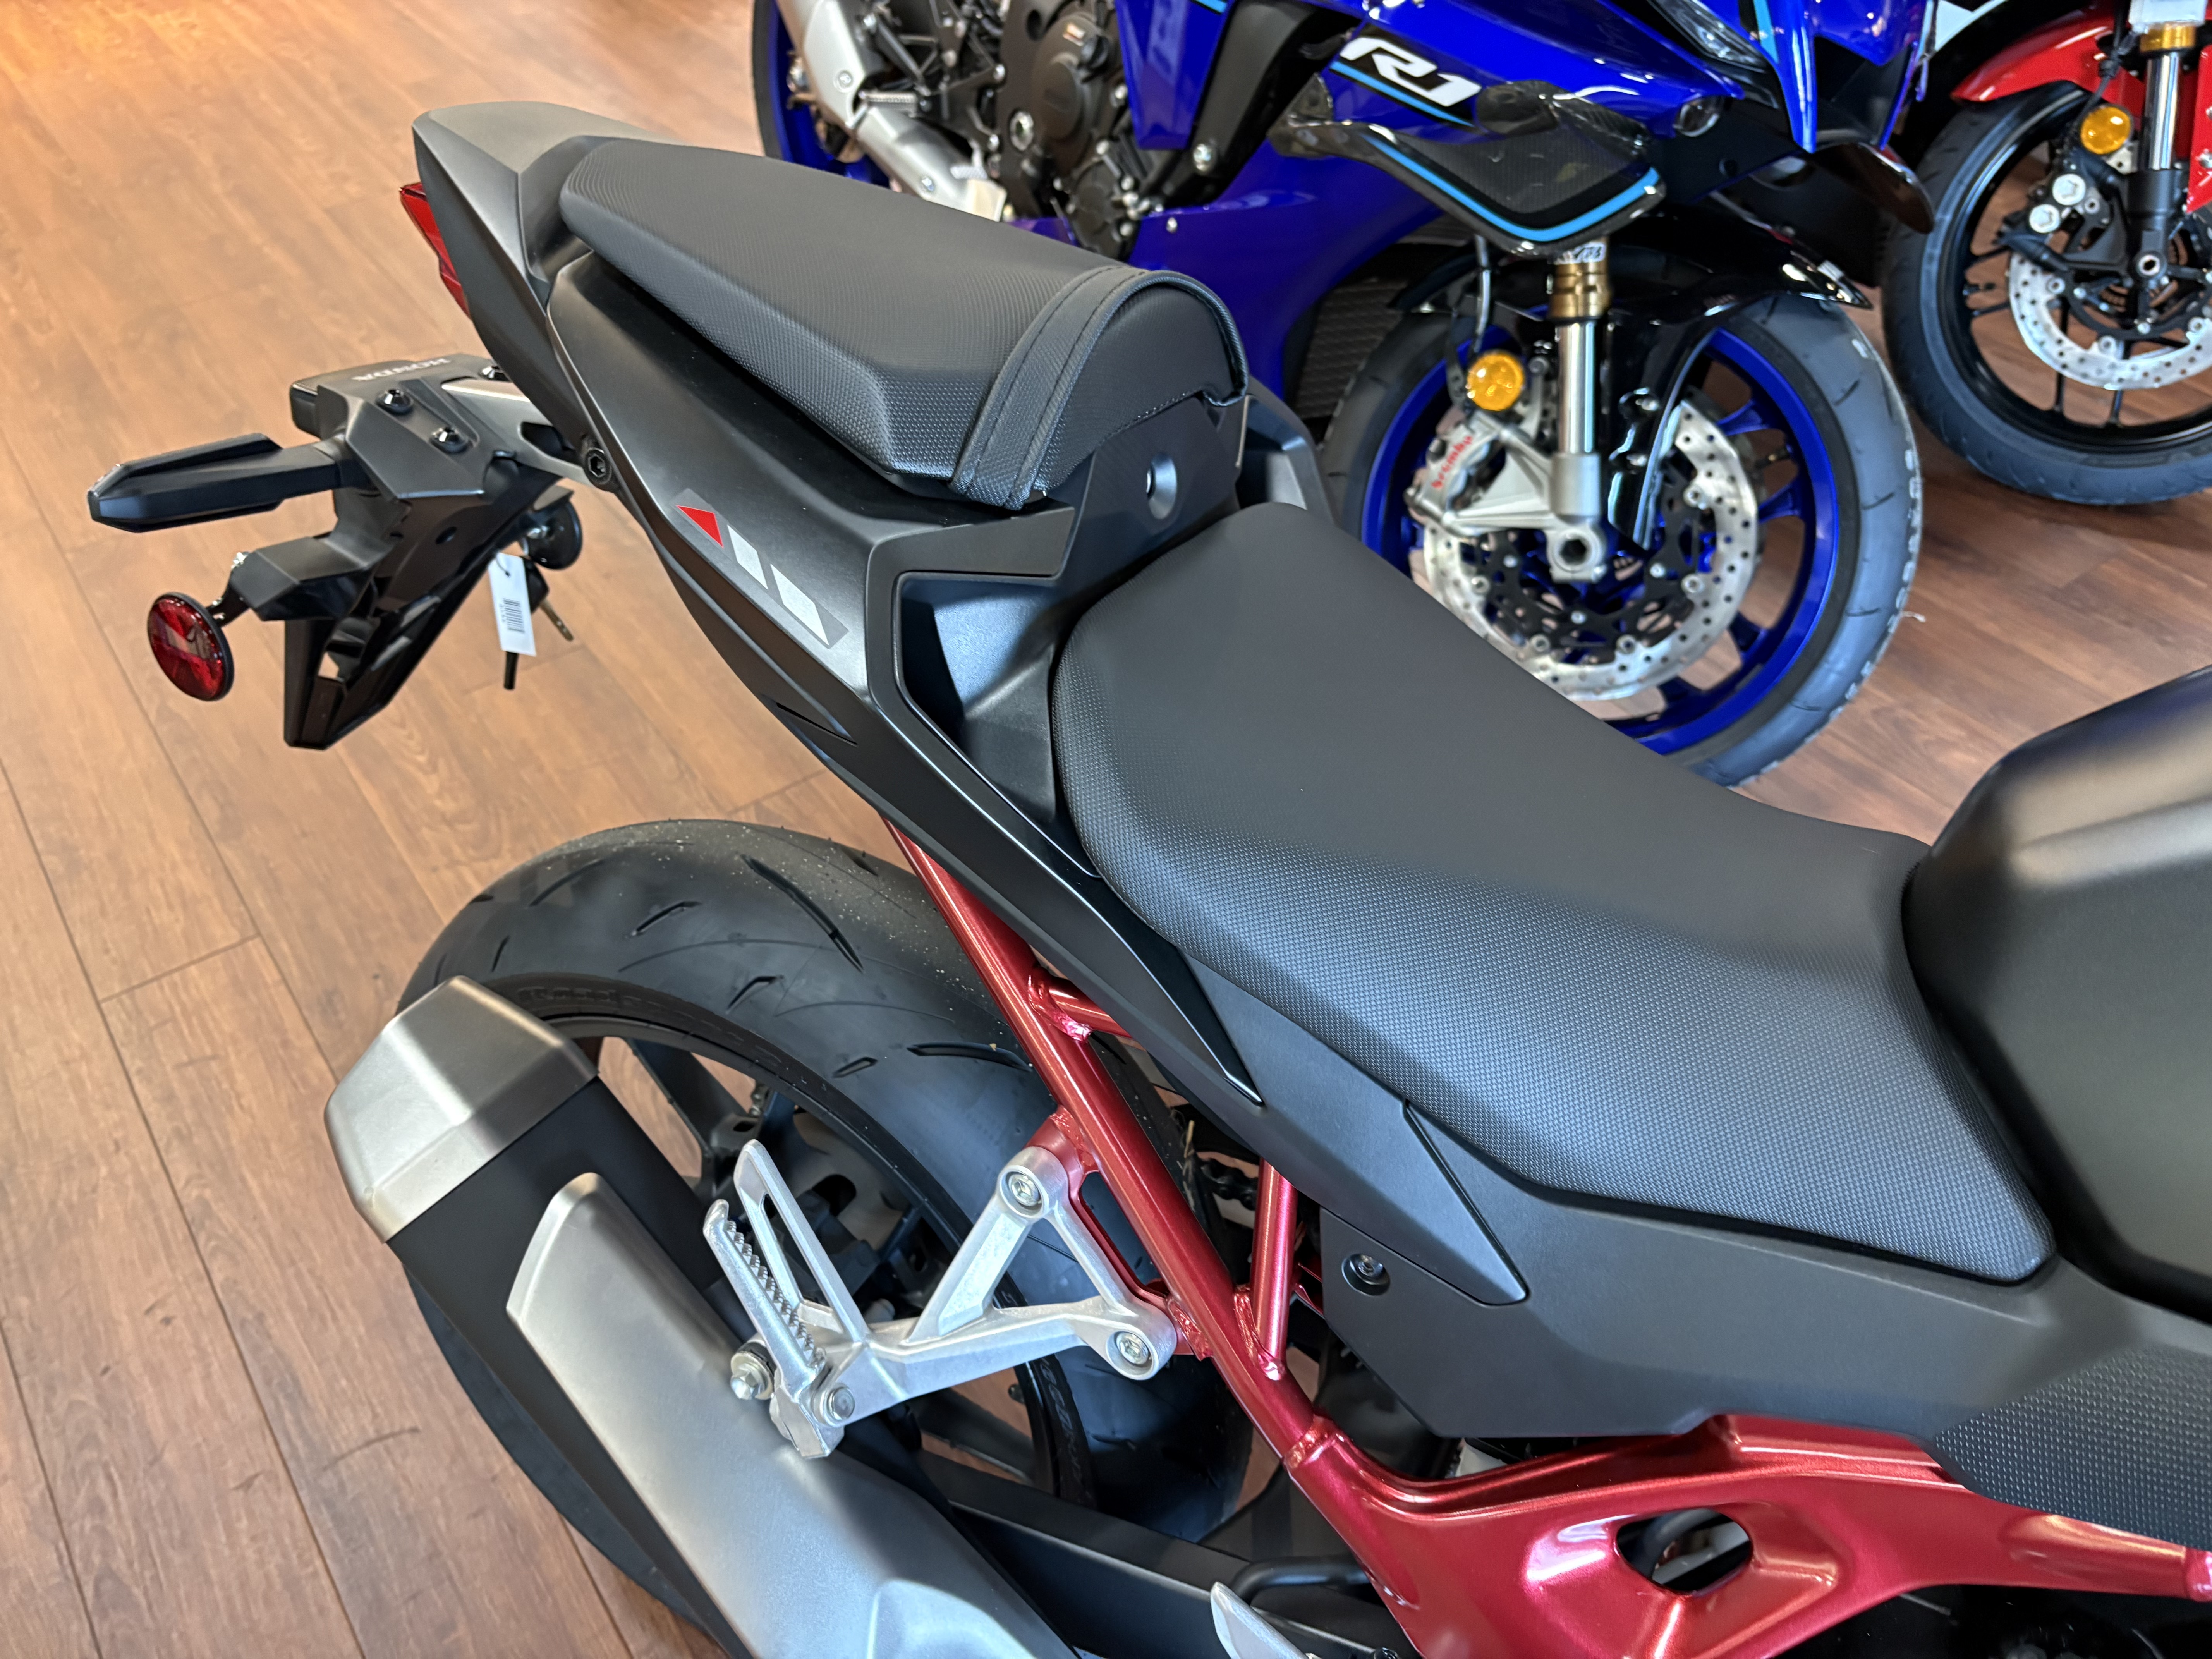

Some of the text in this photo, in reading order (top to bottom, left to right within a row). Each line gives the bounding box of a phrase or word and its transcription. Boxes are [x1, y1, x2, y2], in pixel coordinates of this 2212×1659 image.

[1339, 37, 1482, 107] R1
[350, 358, 451, 381] HONDA
[1431, 435, 1473, 489] brembo
